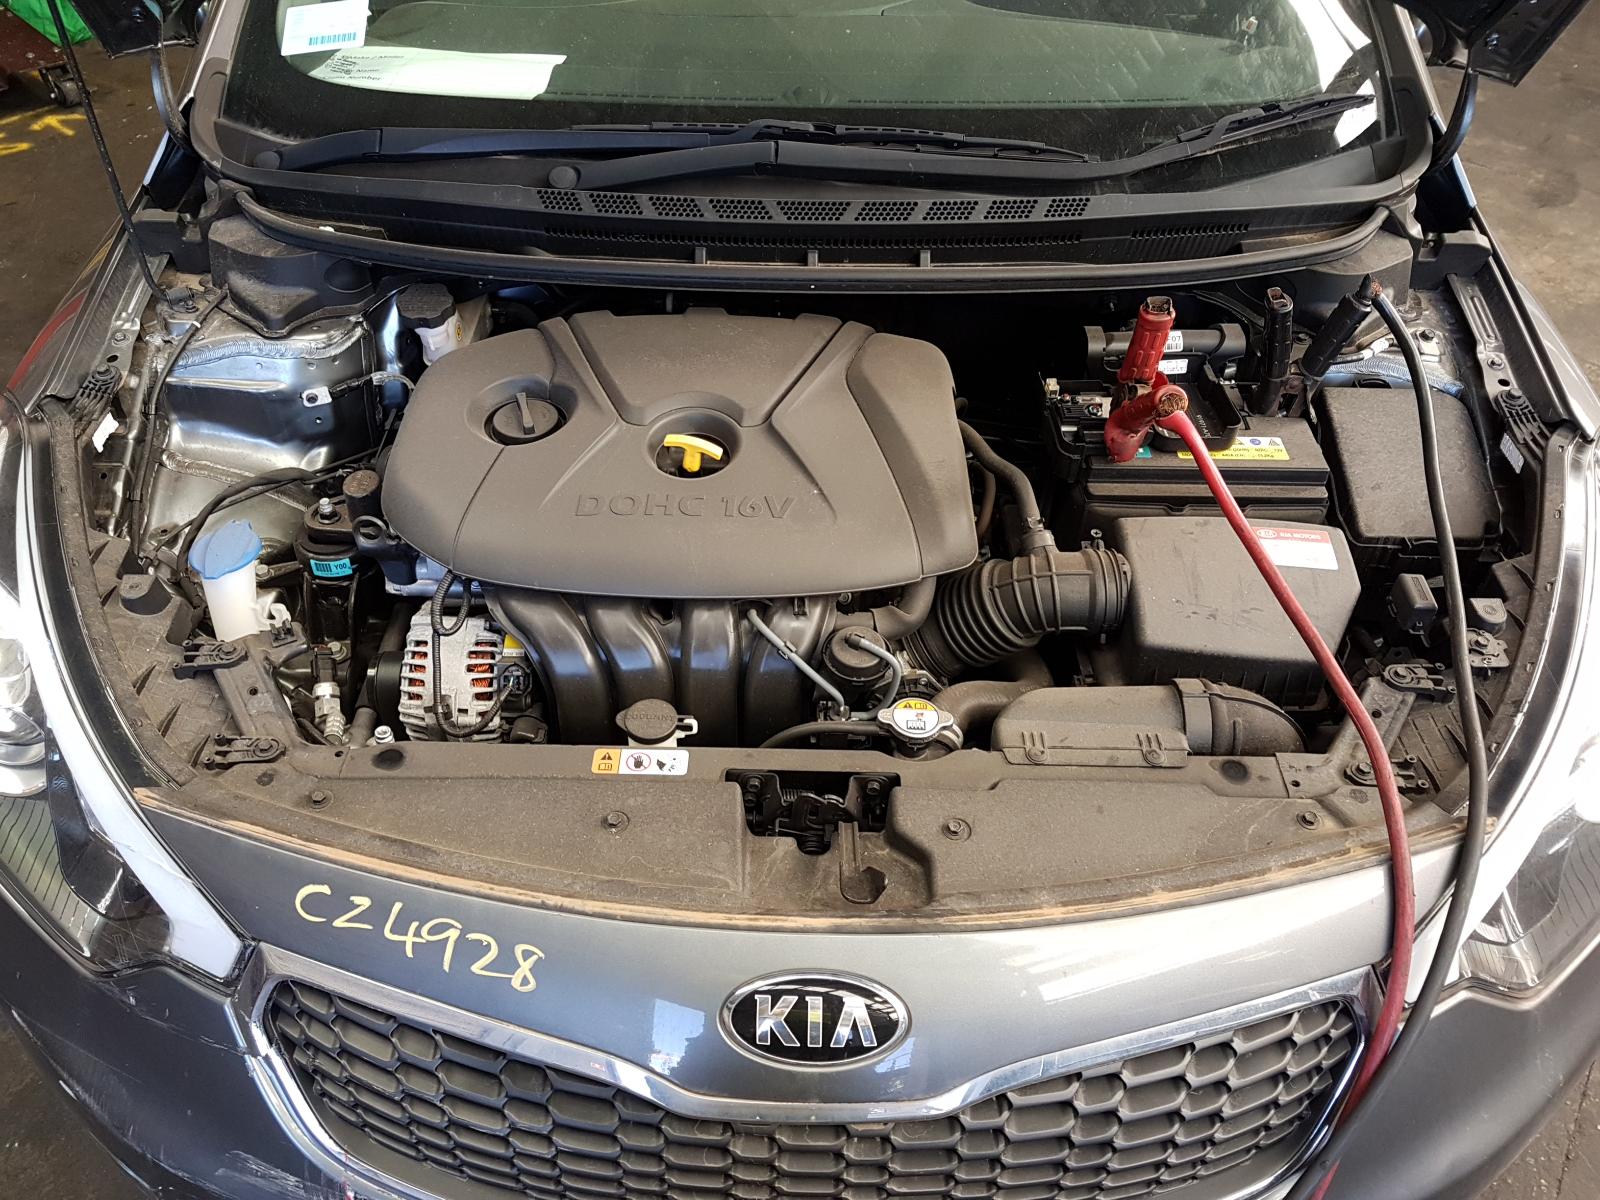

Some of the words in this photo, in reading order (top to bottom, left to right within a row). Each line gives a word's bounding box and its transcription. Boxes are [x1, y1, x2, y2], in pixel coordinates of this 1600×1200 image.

[574, 493, 706, 517] DOHC
[720, 495, 796, 519] 16V
[754, 994, 878, 1049] KIA
